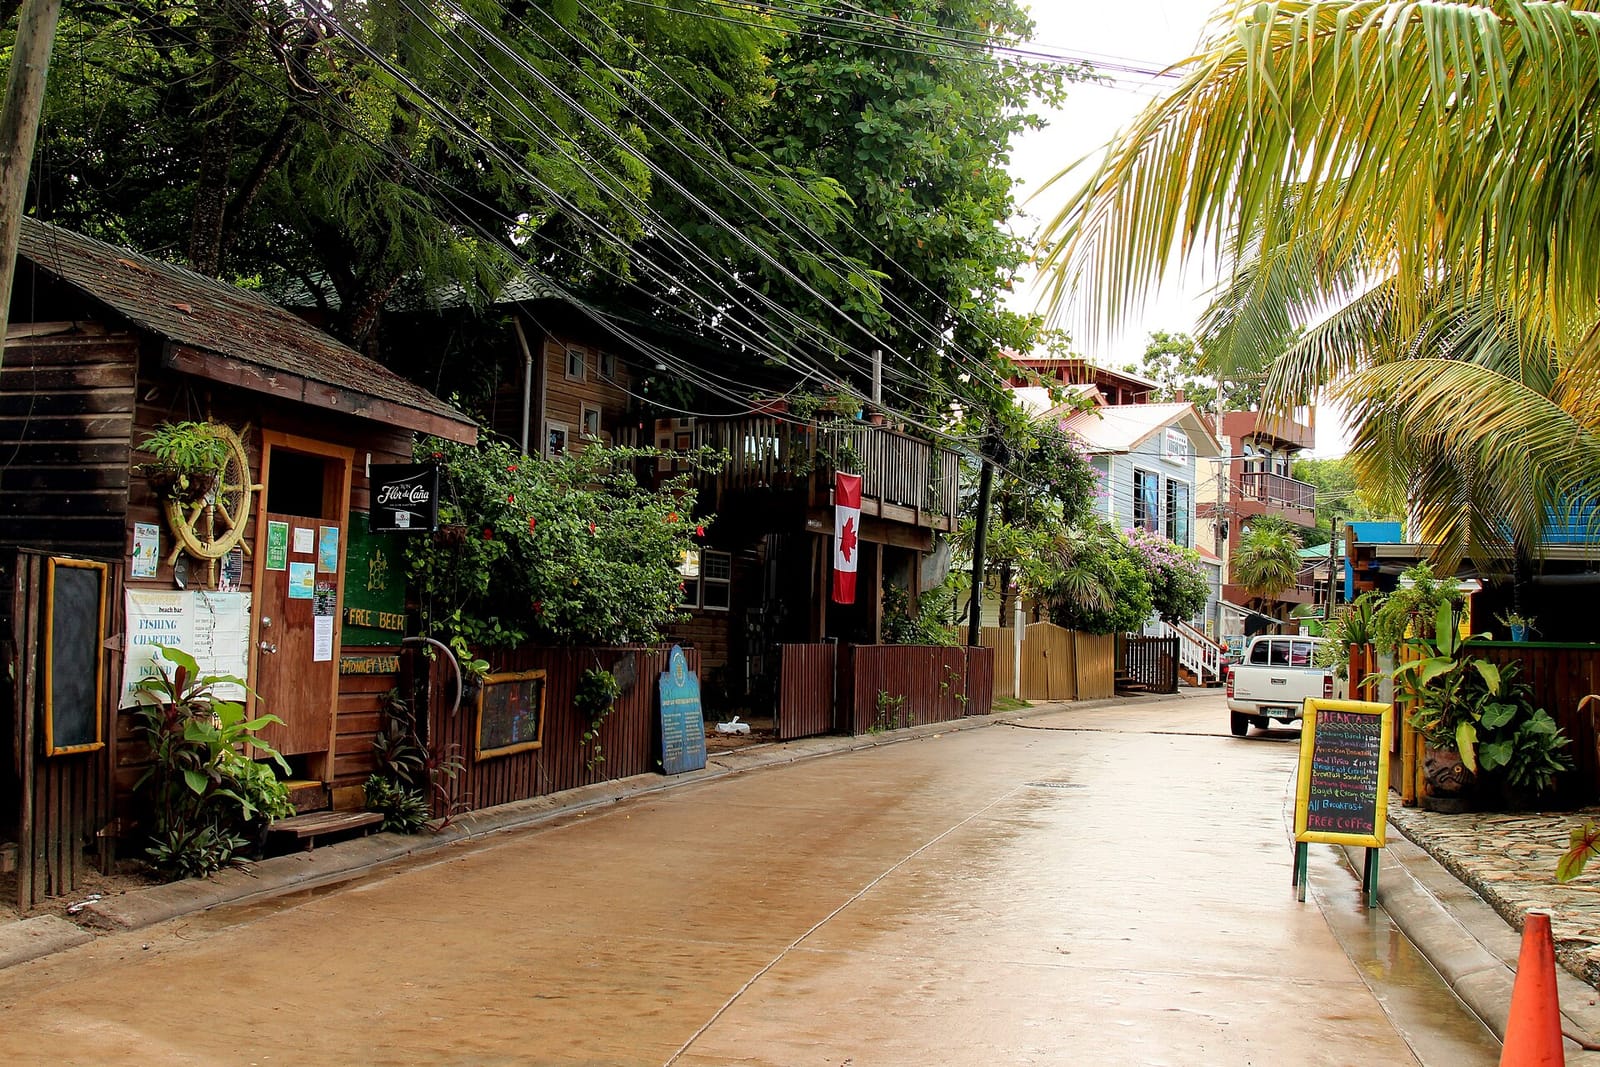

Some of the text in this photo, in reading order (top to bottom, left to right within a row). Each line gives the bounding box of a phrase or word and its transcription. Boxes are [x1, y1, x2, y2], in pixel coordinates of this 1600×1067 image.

[377, 485, 402, 504] Flor
[409, 484, 430, 503] Caña
[139, 619, 177, 630] FISHING
[349, 608, 404, 631] FREE BEER
[133, 634, 181, 646] CHARTERS
[152, 651, 159, 660] &
[140, 666, 172, 676] ISLAD
[342, 657, 375, 674] MONKEY
[1308, 800, 1320, 812] All
[1308, 814, 1334, 827] FREE
